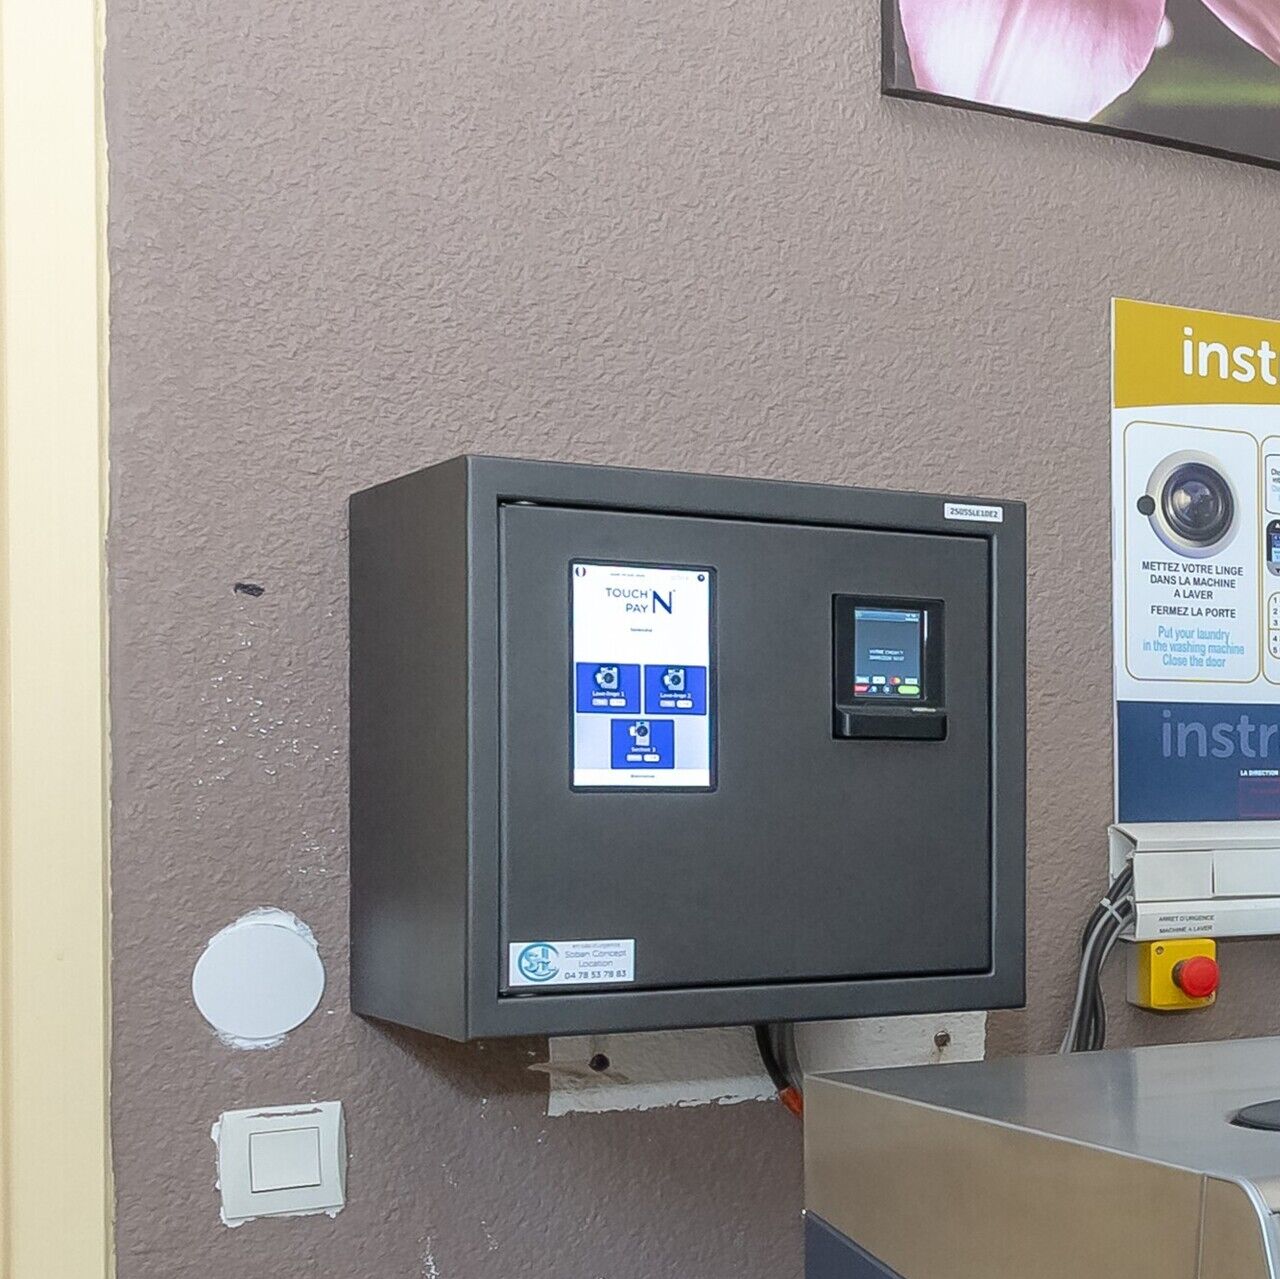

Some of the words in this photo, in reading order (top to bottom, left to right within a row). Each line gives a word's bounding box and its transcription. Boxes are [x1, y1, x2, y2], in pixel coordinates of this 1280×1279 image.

[1142, 561, 1180, 572] METTEZ
[1182, 564, 1213, 574] VOTRE
[1216, 566, 1244, 576] LINGE
[1150, 575, 1177, 585] DANS
[1179, 576, 1191, 586] LA
[1193, 578, 1236, 588] MACHINE
[606, 588, 648, 599] TOUCH
[1174, 589, 1181, 598] A
[1183, 590, 1213, 599] LAVER
[626, 603, 648, 613] PAY
[1151, 605, 1189, 616] FERMEZ
[1191, 608, 1203, 617] LA
[1206, 608, 1236, 618] PORTE
[1158, 626, 1173, 638] Put
[1176, 630, 1195, 641] your
[1198, 628, 1231, 644] laundry
[1143, 640, 1152, 651] in
[1154, 640, 1168, 652] the
[1170, 641, 1206, 656] washing
[1208, 644, 1245, 655] machine
[1163, 654, 1188, 666] Close
[1190, 655, 1204, 667] the
[1206, 656, 1226, 667] door
